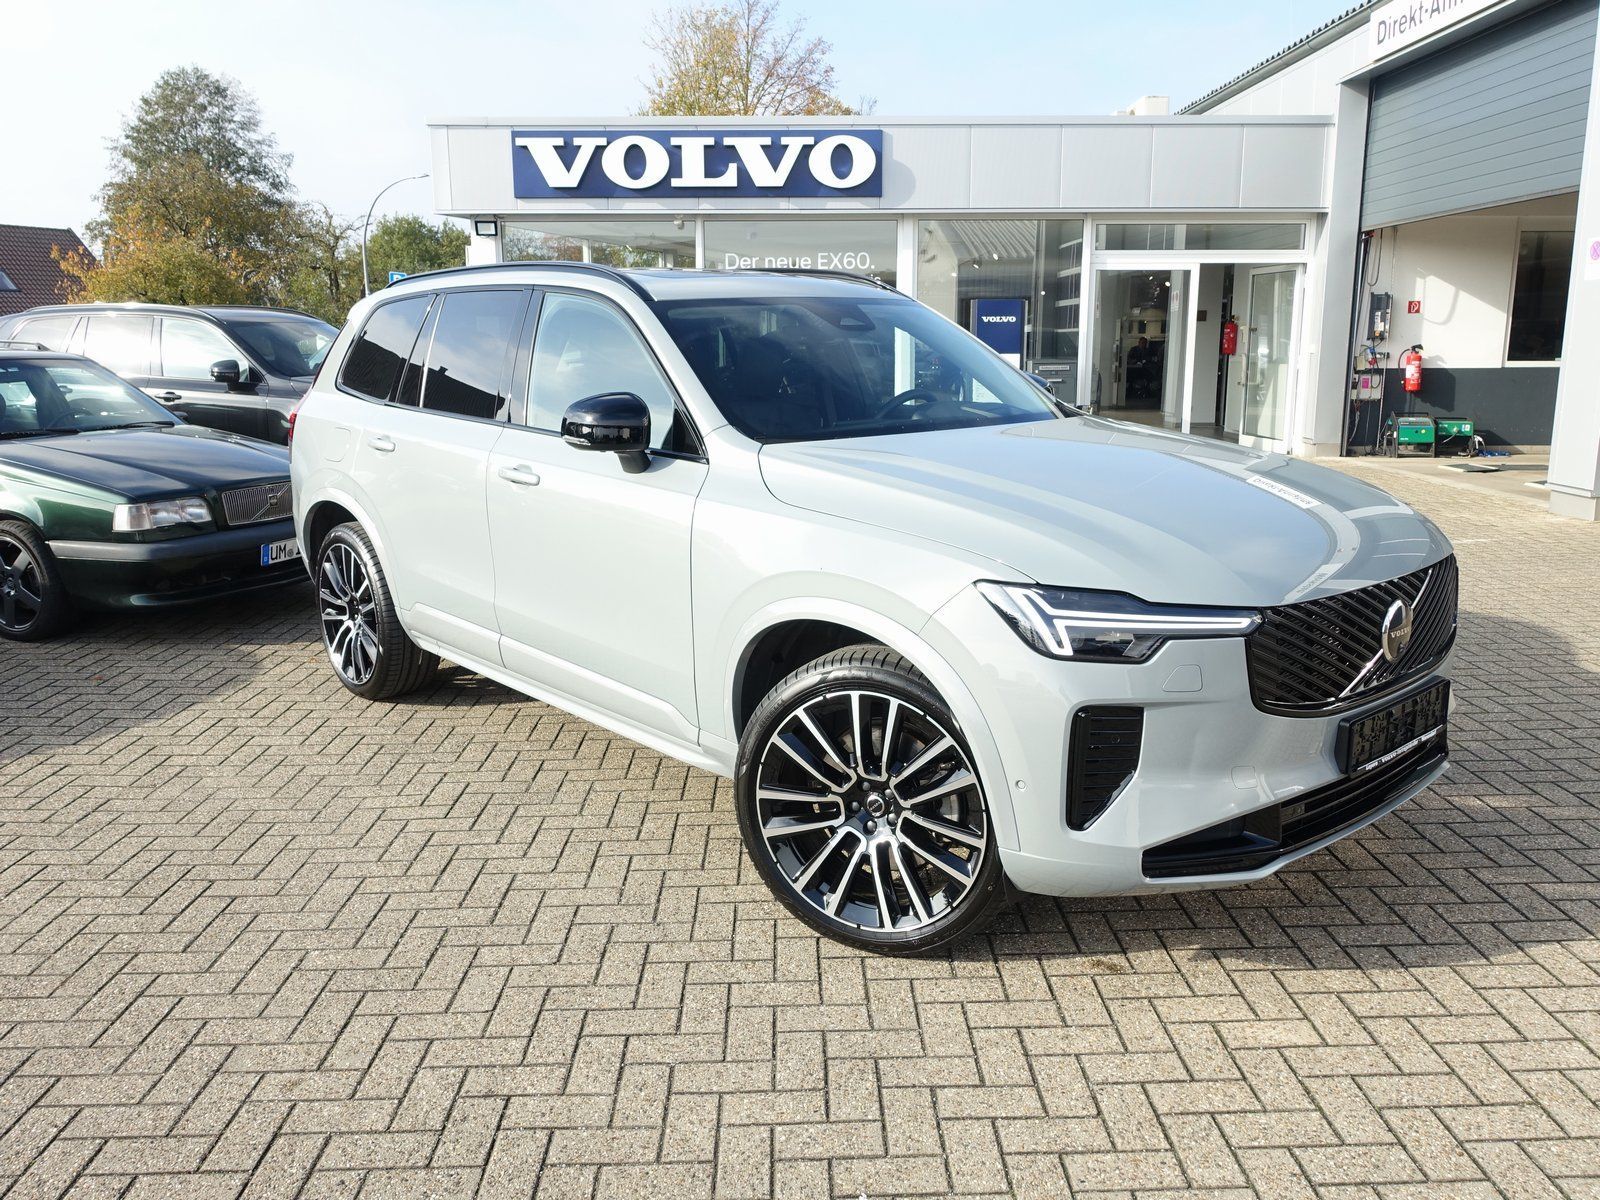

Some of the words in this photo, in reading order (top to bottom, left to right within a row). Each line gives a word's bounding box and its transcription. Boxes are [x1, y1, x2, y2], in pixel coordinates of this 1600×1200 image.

[515, 135, 876, 189] VOLVO
[725, 253, 759, 270] Der
[764, 255, 812, 269] neue
[817, 252, 875, 270] EX60.
[981, 315, 1017, 323] VOLVO
[270, 543, 287, 561] UM
